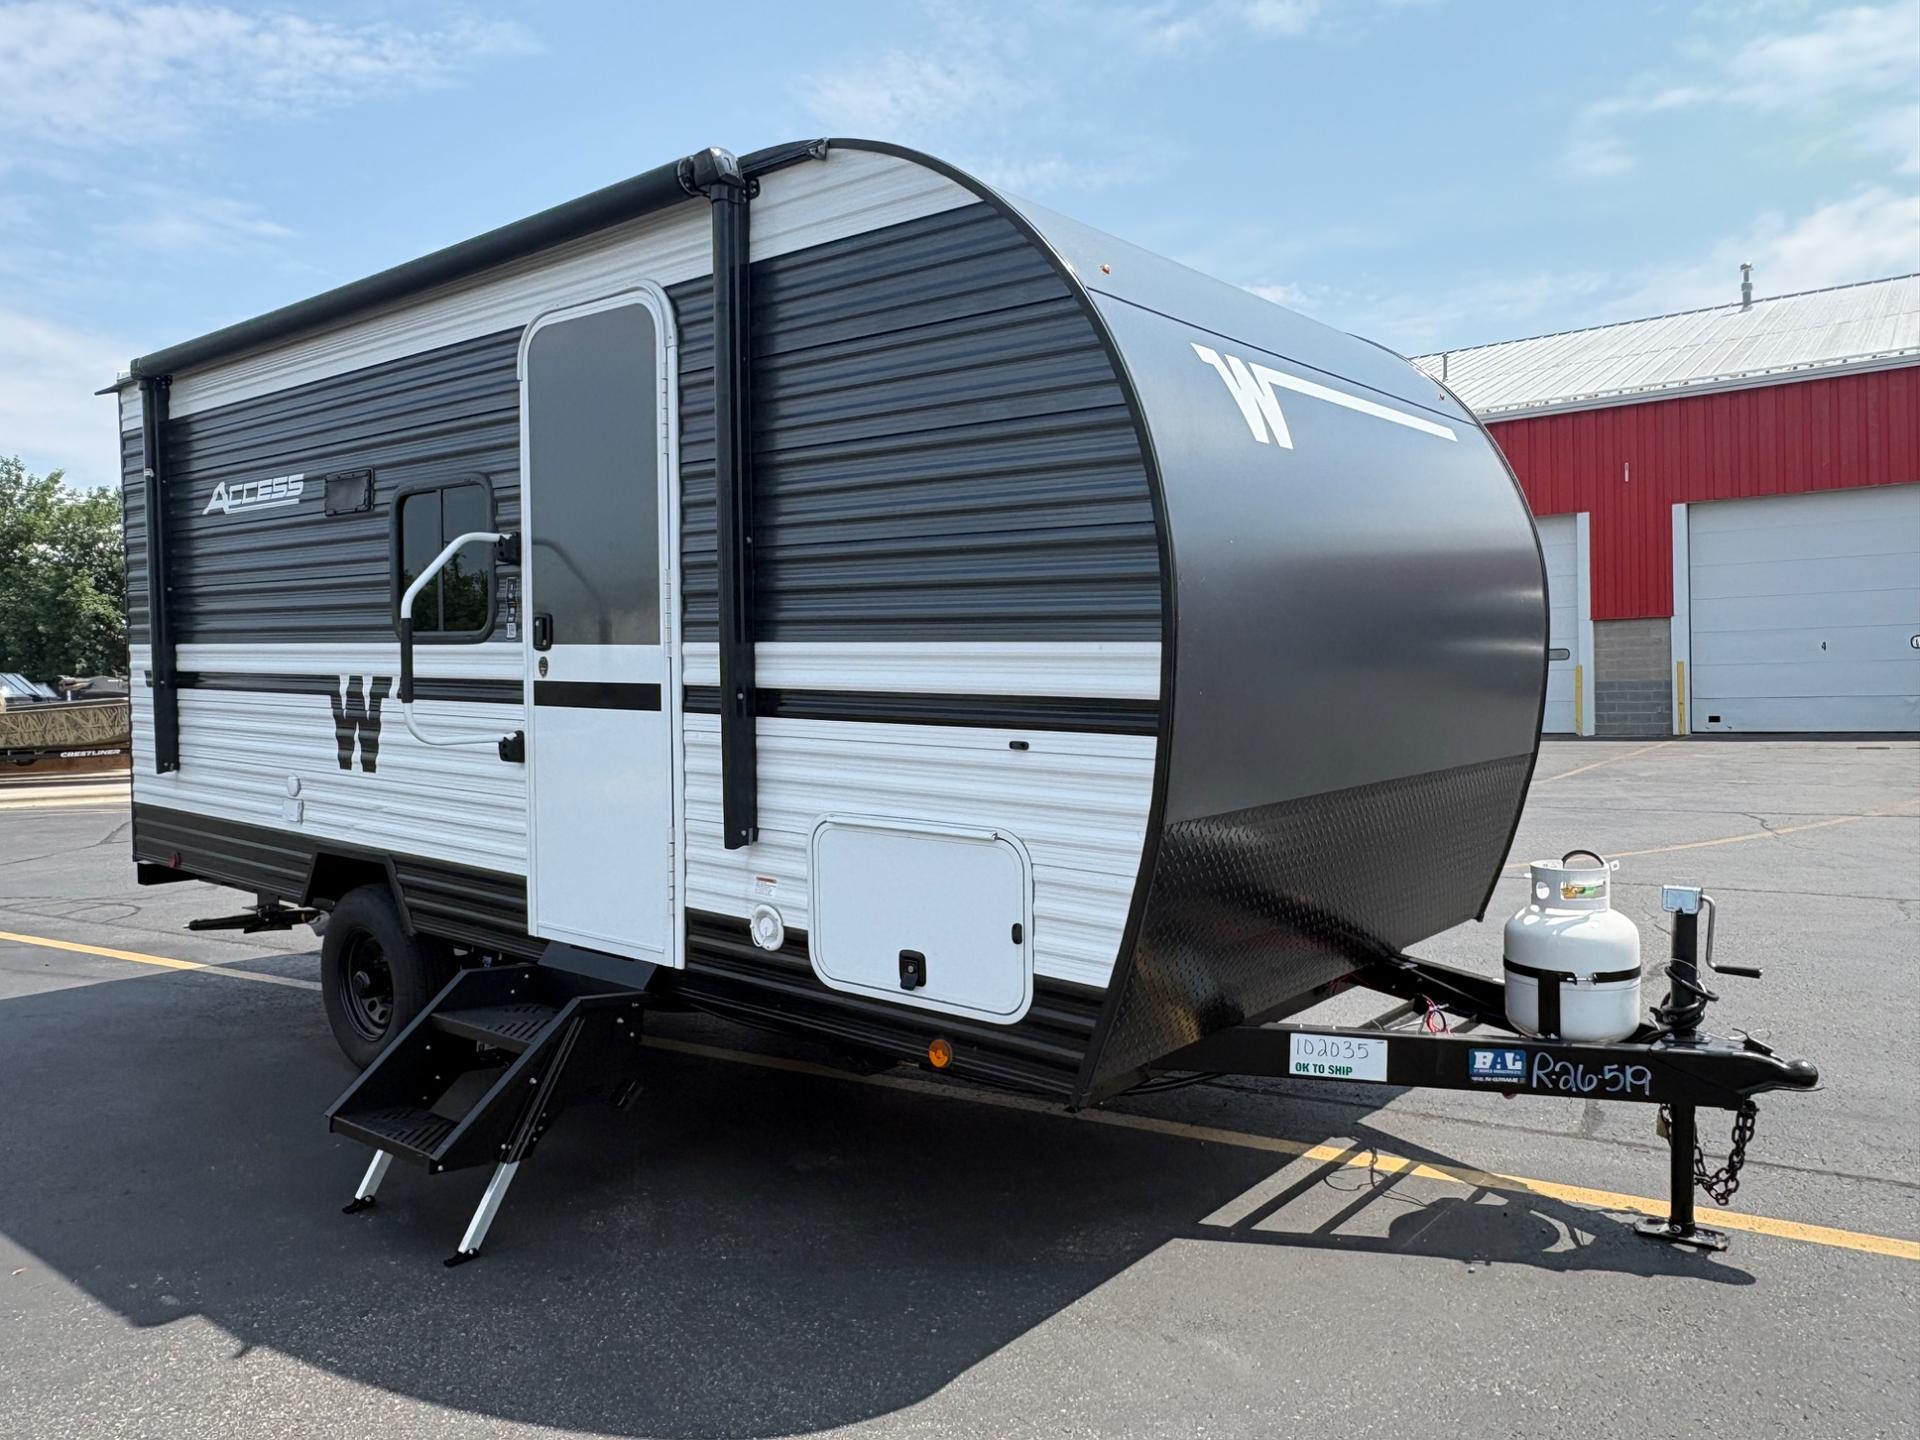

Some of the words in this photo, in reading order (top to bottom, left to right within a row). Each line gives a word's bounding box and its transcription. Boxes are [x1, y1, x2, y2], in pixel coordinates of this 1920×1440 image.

[202, 473, 304, 515] ACCESS
[60, 749, 120, 758] CRESTLINER
[1296, 1038, 1369, 1060] 102035
[1295, 1062, 1310, 1073] OK
[1312, 1063, 1325, 1074] TO
[1328, 1065, 1353, 1076] SHIP
